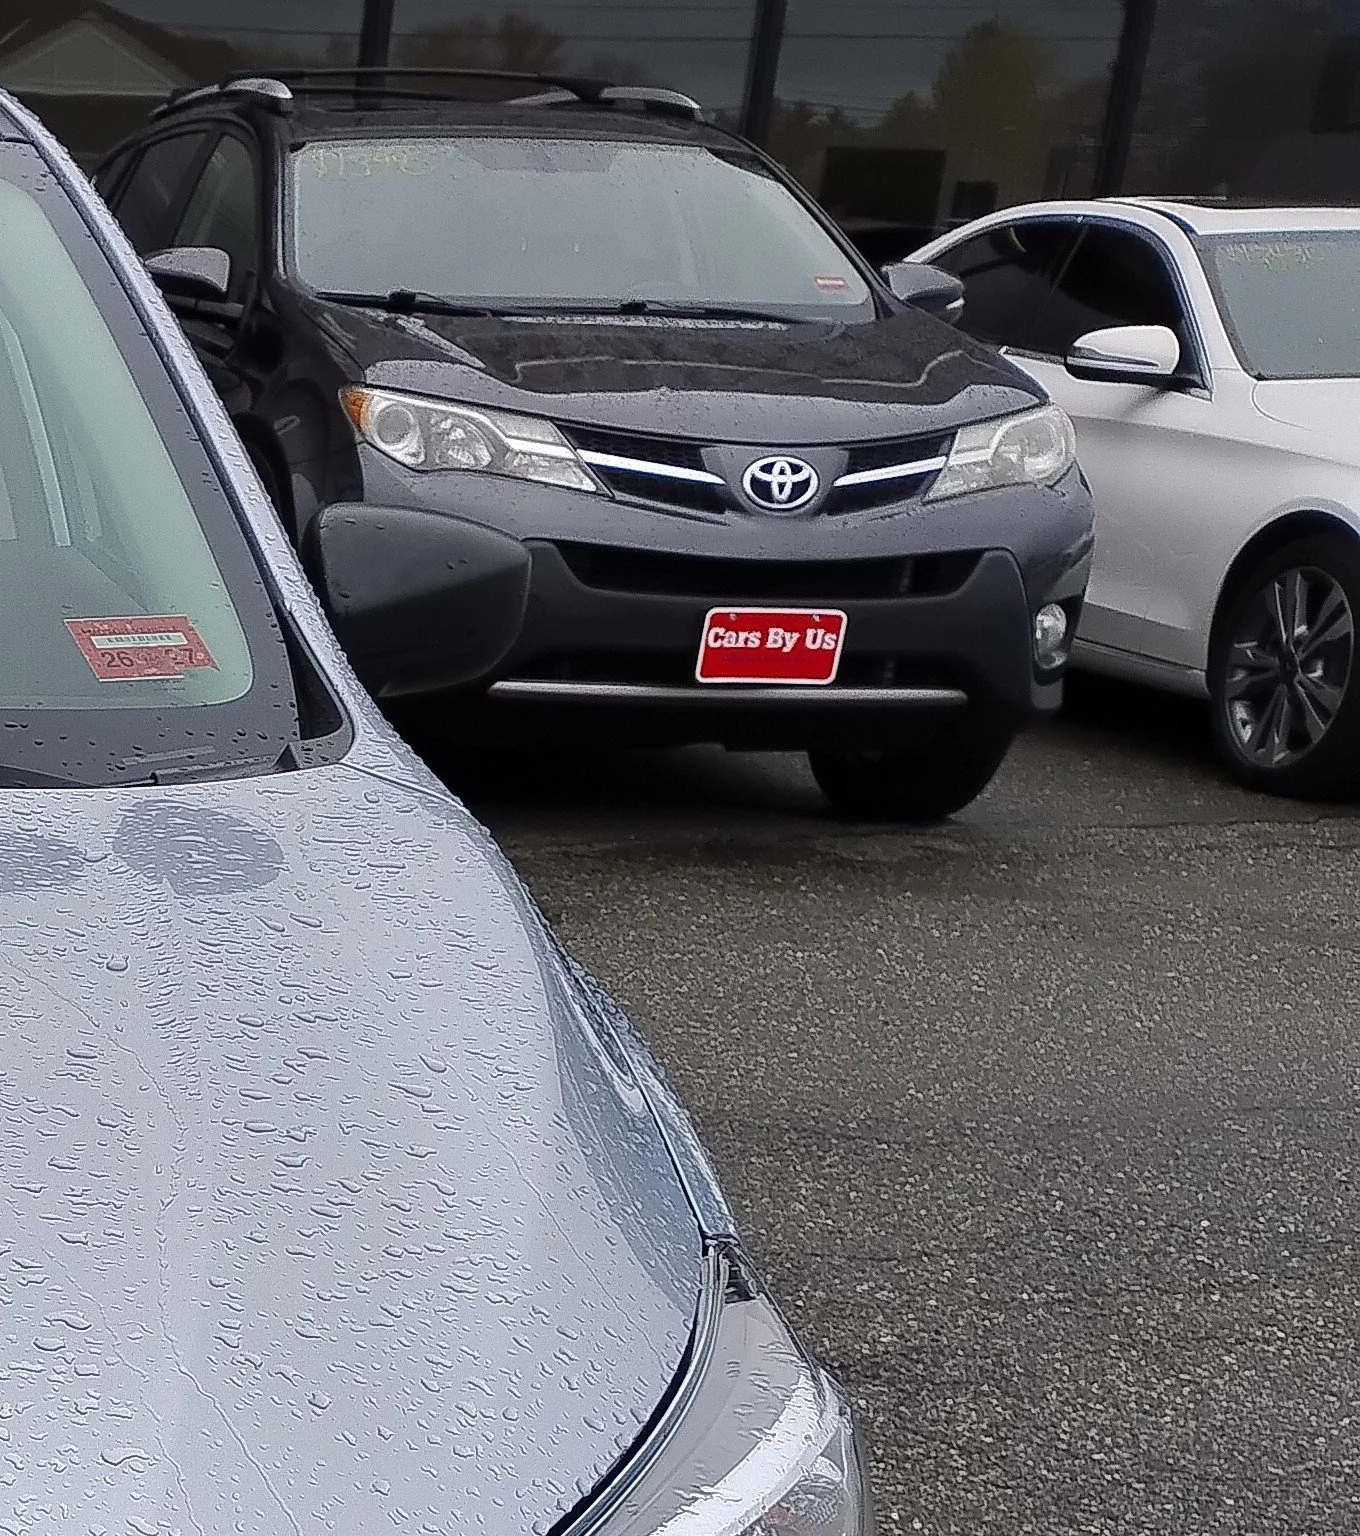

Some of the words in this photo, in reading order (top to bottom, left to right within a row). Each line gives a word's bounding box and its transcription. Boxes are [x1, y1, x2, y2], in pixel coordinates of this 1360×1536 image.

[707, 626, 761, 648] Cars
[766, 627, 800, 652] By
[805, 628, 837, 650] Us
[100, 650, 134, 668] 26
